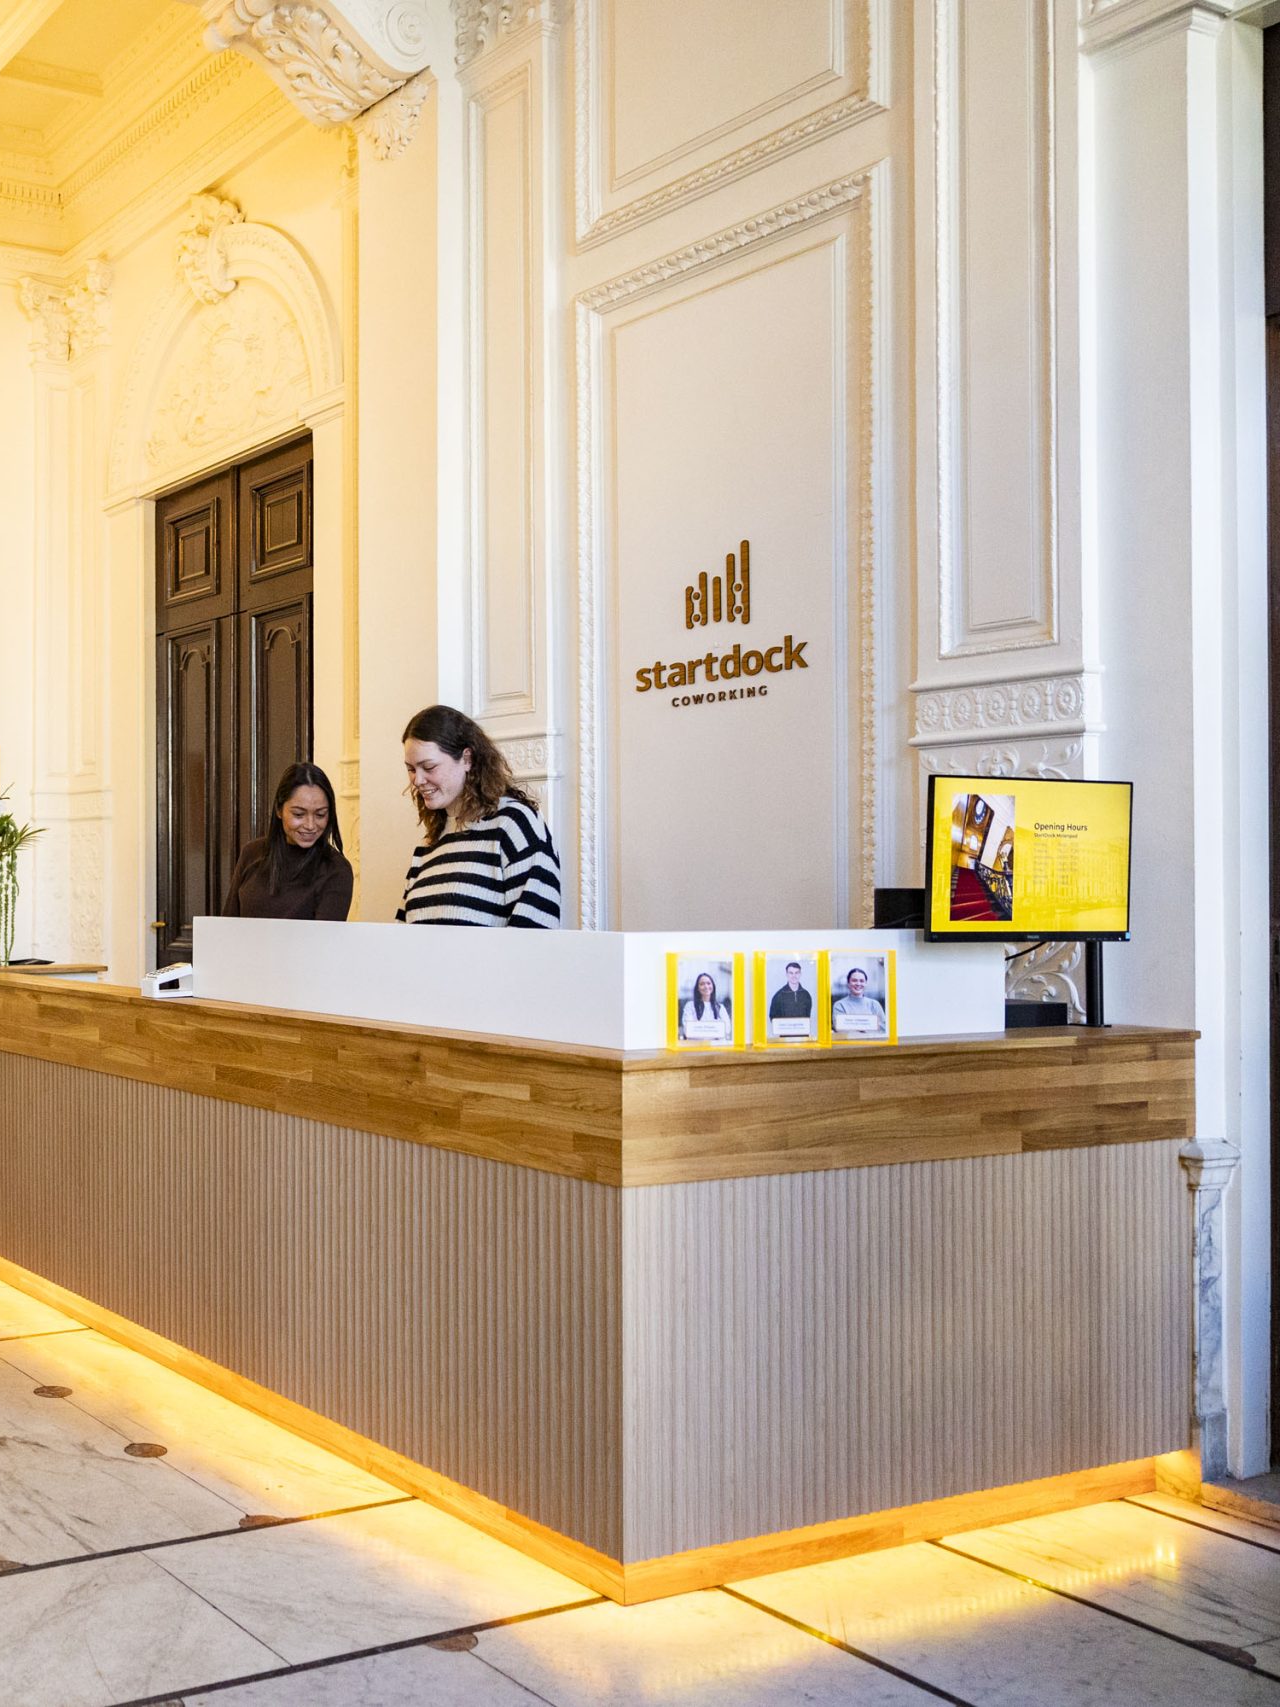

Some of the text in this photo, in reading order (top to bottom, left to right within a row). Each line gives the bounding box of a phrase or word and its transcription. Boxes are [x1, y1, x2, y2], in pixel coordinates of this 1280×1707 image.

[636, 635, 808, 692] startdock
[671, 685, 768, 707] COWORKING
[1034, 822, 1088, 832] Opening Hours
